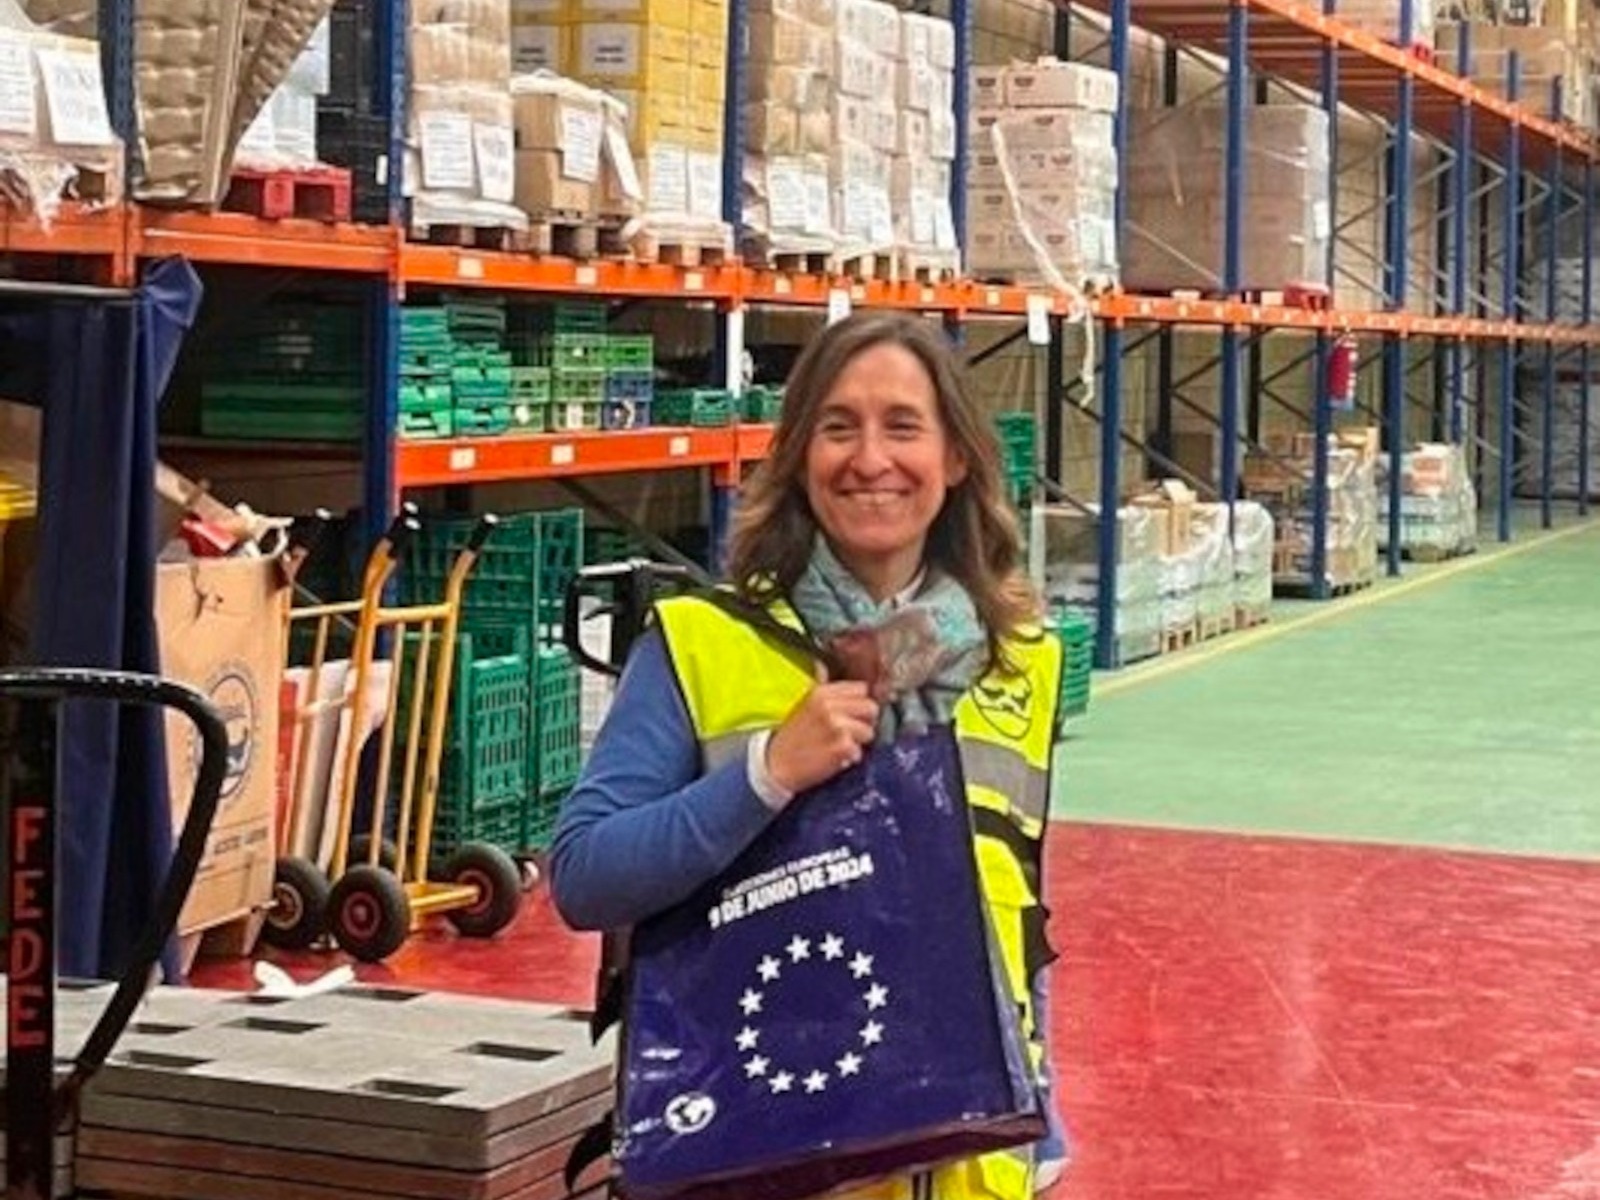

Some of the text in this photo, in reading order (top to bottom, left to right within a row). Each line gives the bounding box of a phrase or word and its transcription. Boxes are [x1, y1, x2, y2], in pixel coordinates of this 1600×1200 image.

[11, 806, 46, 1046] FEDE
[708, 852, 874, 930] 9 DE JUNIO DE 2024
